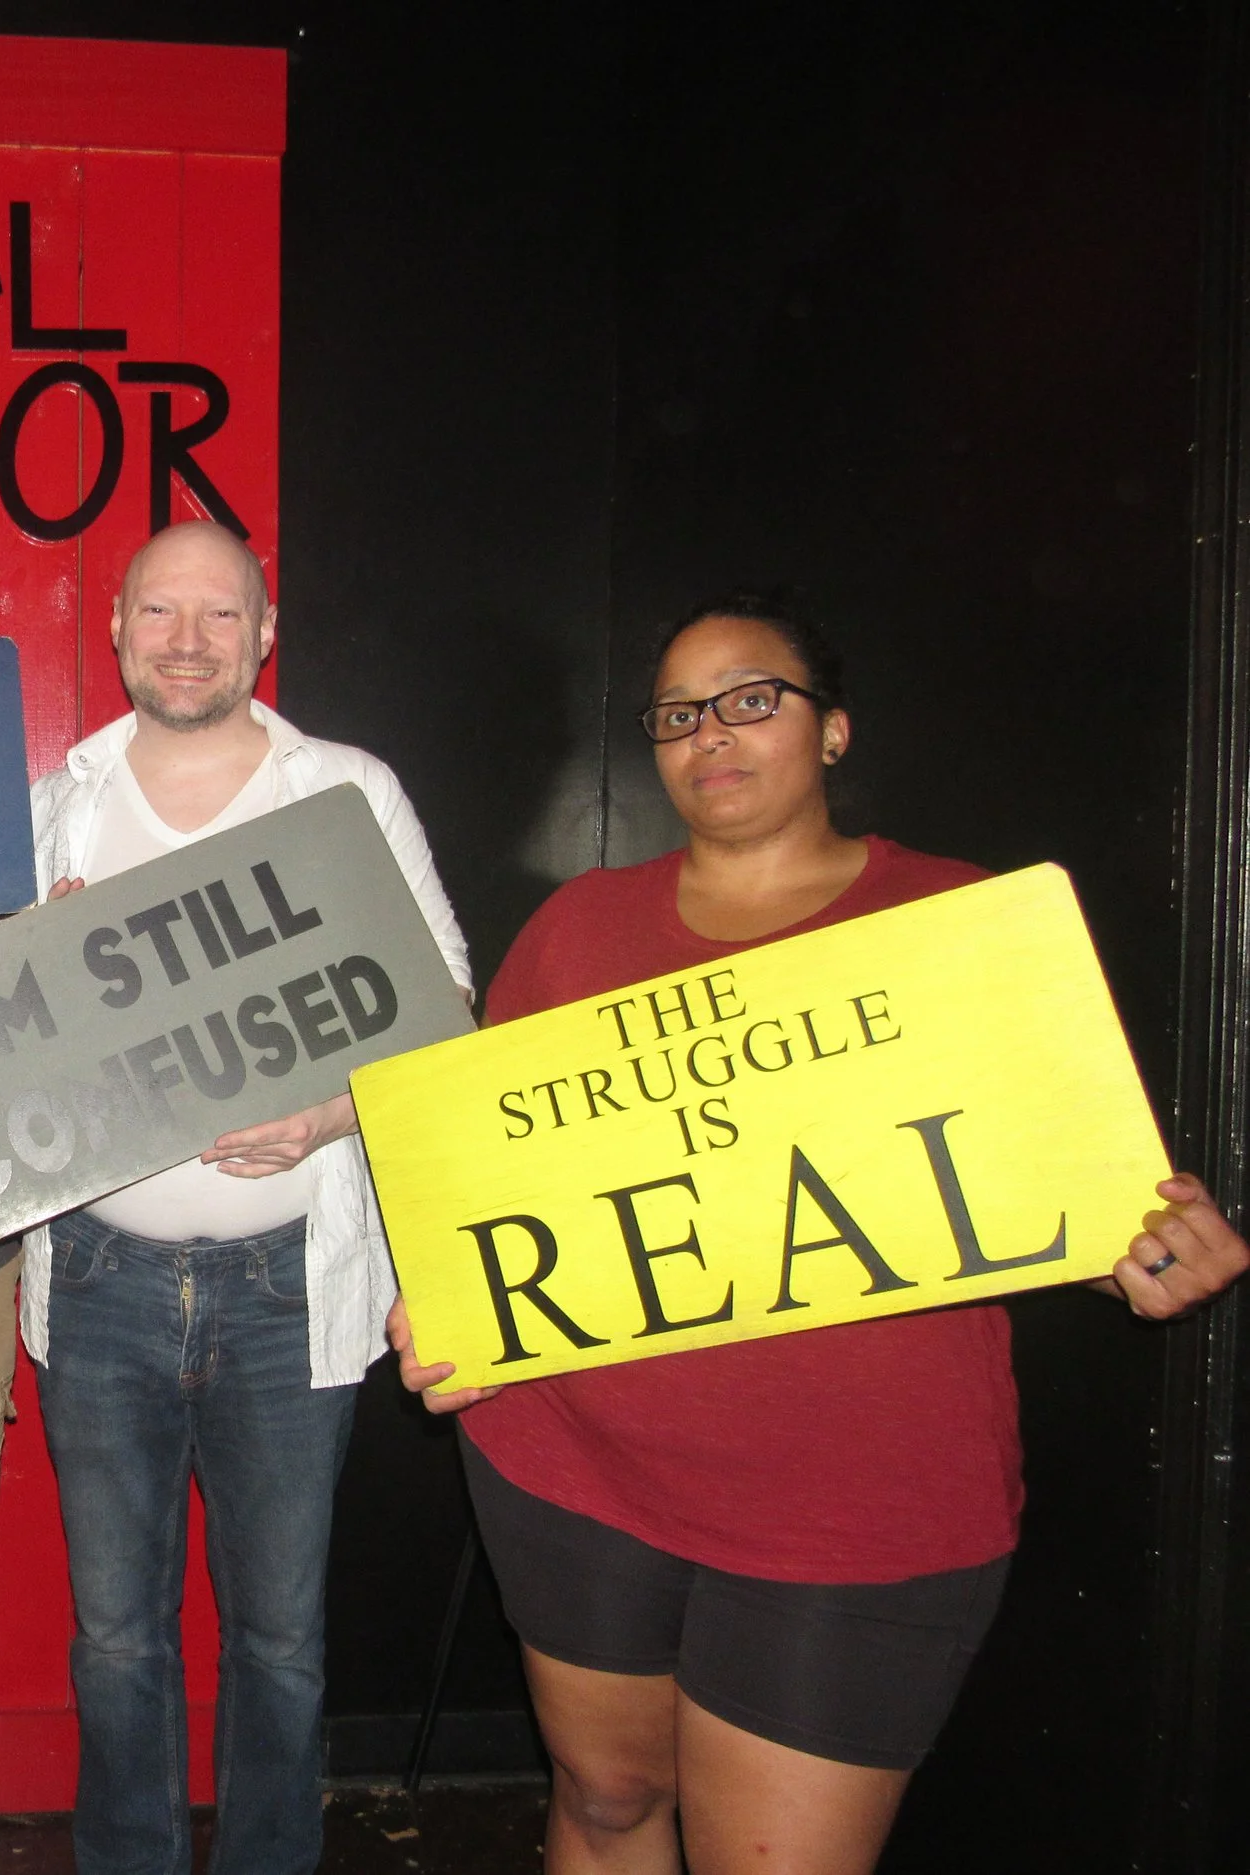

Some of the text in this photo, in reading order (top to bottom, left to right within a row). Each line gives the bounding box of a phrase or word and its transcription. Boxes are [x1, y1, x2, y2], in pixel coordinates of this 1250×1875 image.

[82, 860, 323, 1009] STILL
[597, 968, 747, 1050] THE
[498, 990, 903, 1141] STRUGGLE
[679, 1096, 739, 1156] IS
[457, 1109, 1067, 1366] REAL
